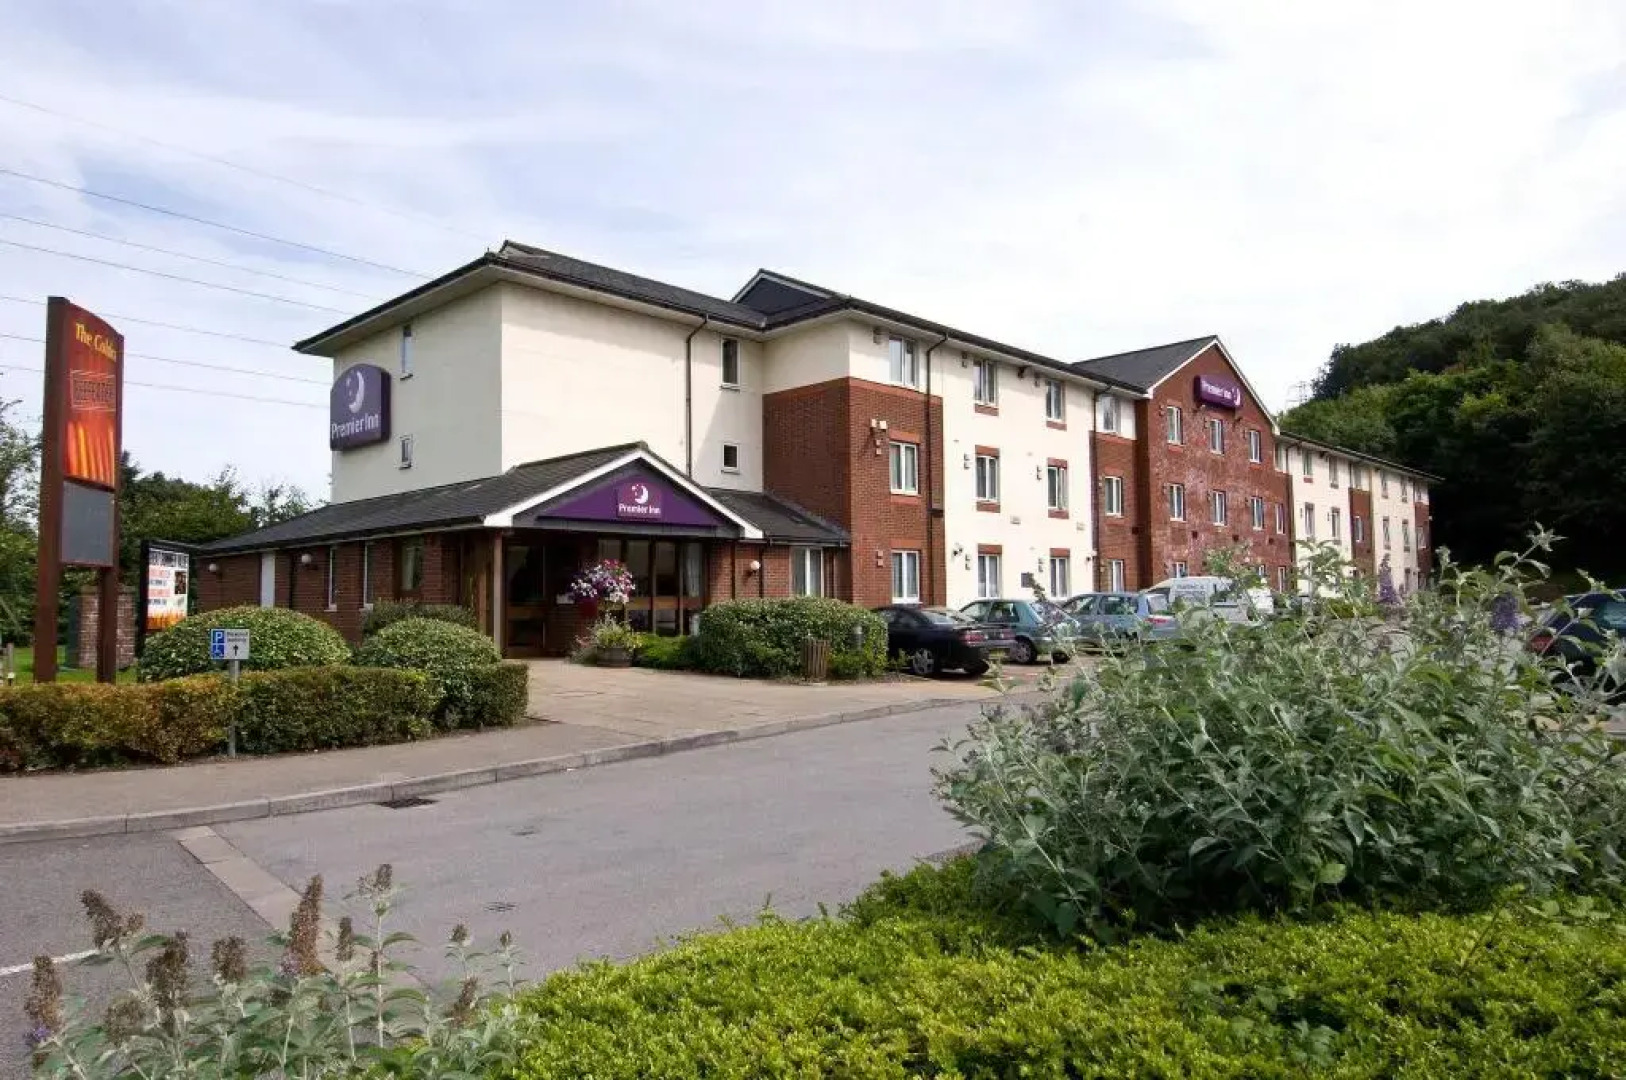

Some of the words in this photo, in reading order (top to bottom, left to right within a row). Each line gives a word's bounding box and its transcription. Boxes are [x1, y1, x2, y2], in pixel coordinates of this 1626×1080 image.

[75, 322, 93, 347] The
[331, 417, 364, 440] Premier
[364, 412, 379, 431] Inn
[618, 503, 649, 514] Premier
[649, 504, 661, 514] Inn
